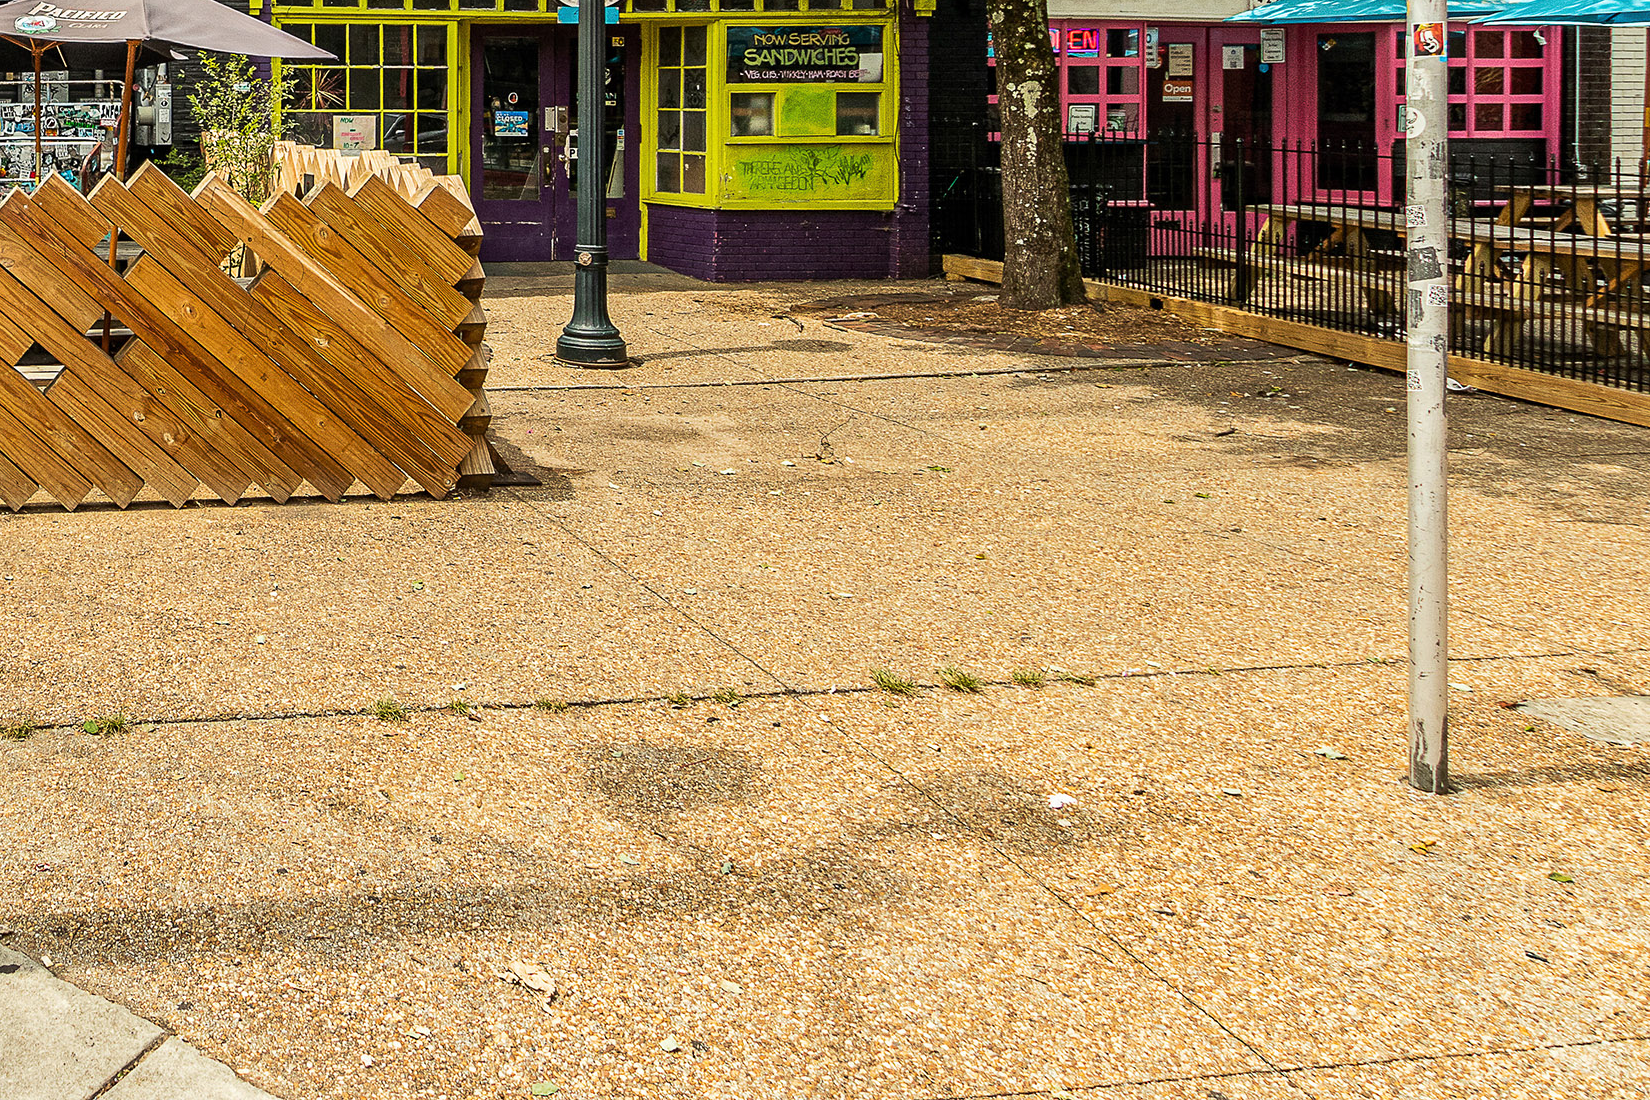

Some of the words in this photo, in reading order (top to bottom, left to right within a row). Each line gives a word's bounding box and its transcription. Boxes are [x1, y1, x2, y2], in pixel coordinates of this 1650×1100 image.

[28, 0, 128, 21] PACIFICO
[754, 34, 787, 46] NOW
[788, 32, 850, 46] SERVING
[743, 46, 859, 67] SANDWICHES
[1164, 83, 1192, 95] Open
